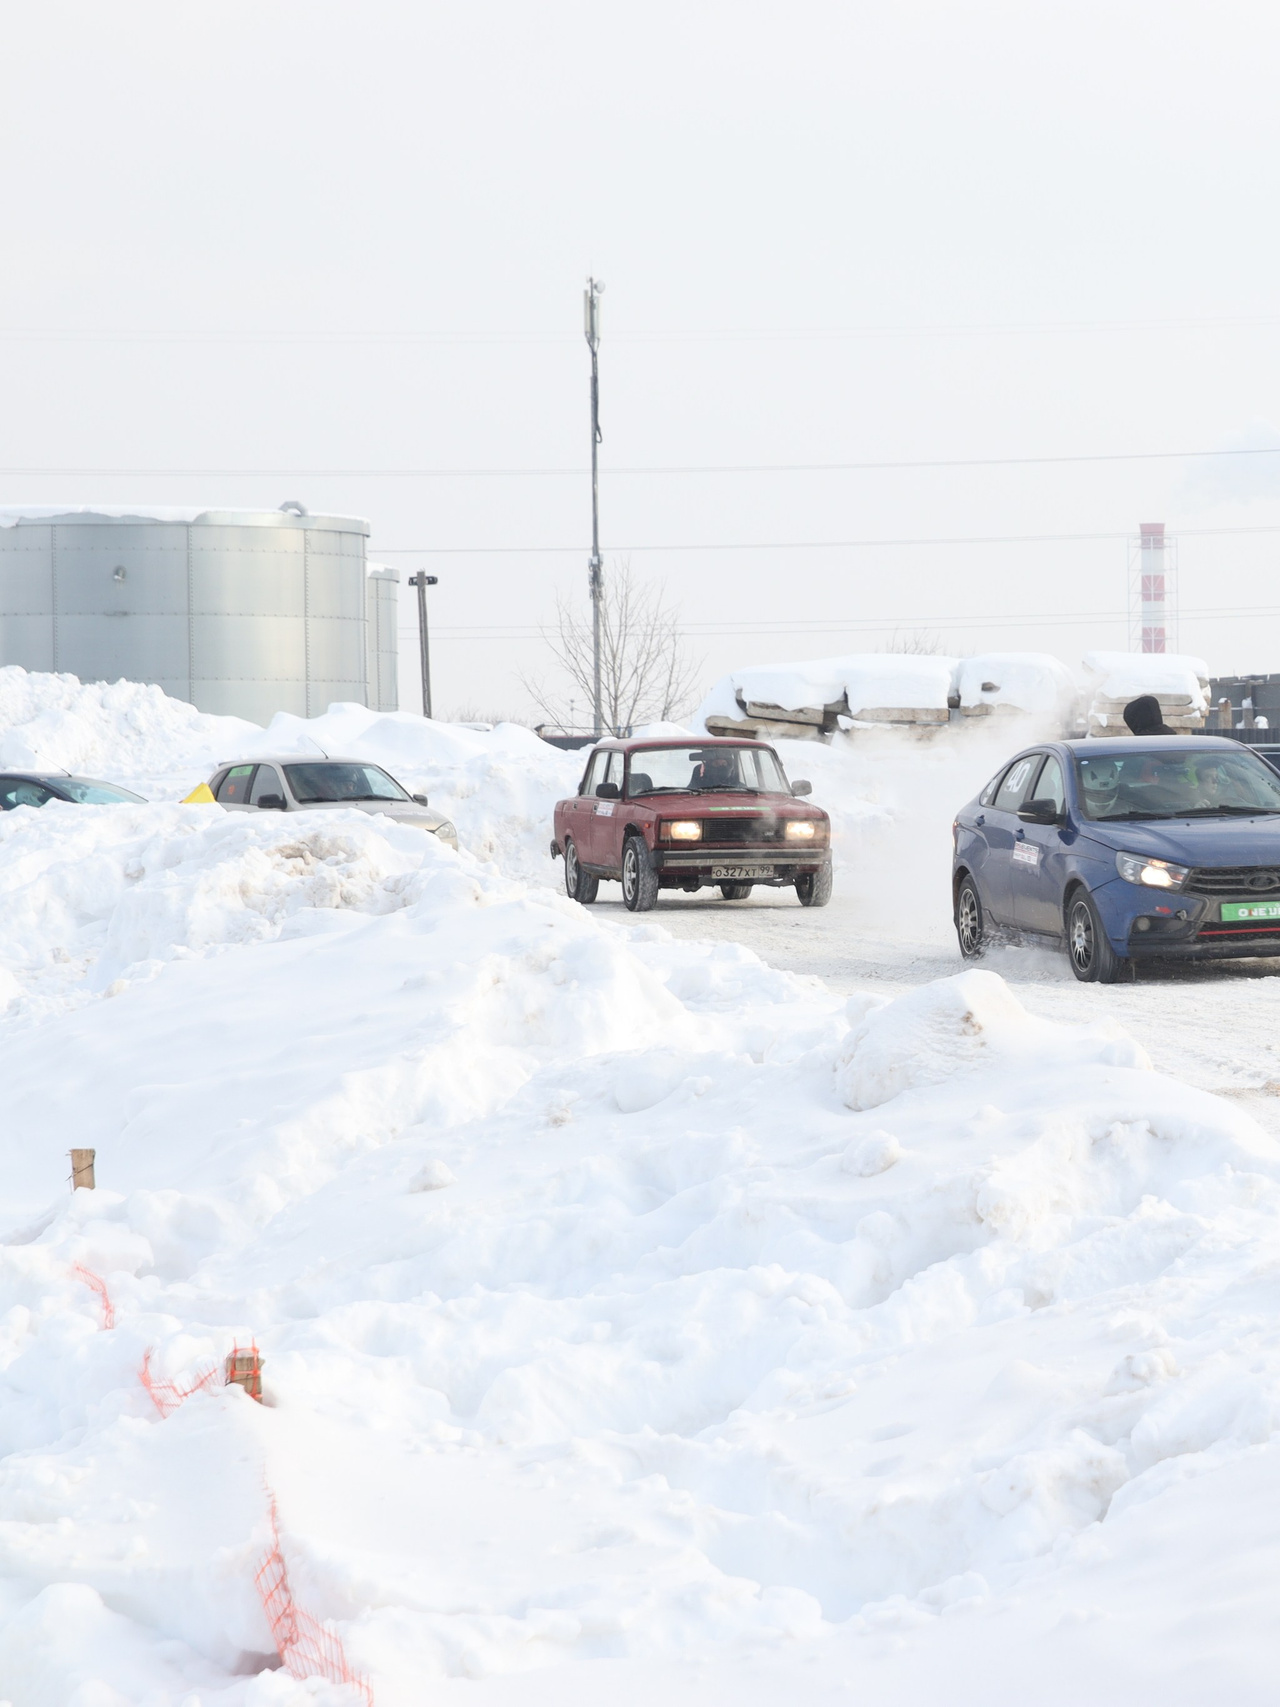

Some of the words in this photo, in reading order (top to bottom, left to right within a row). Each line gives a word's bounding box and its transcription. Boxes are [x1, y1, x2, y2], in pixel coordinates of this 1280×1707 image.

[715, 867, 757, 877] О327ХТ
[760, 866, 771, 874] 99
[1238, 908, 1267, 917] ONE
